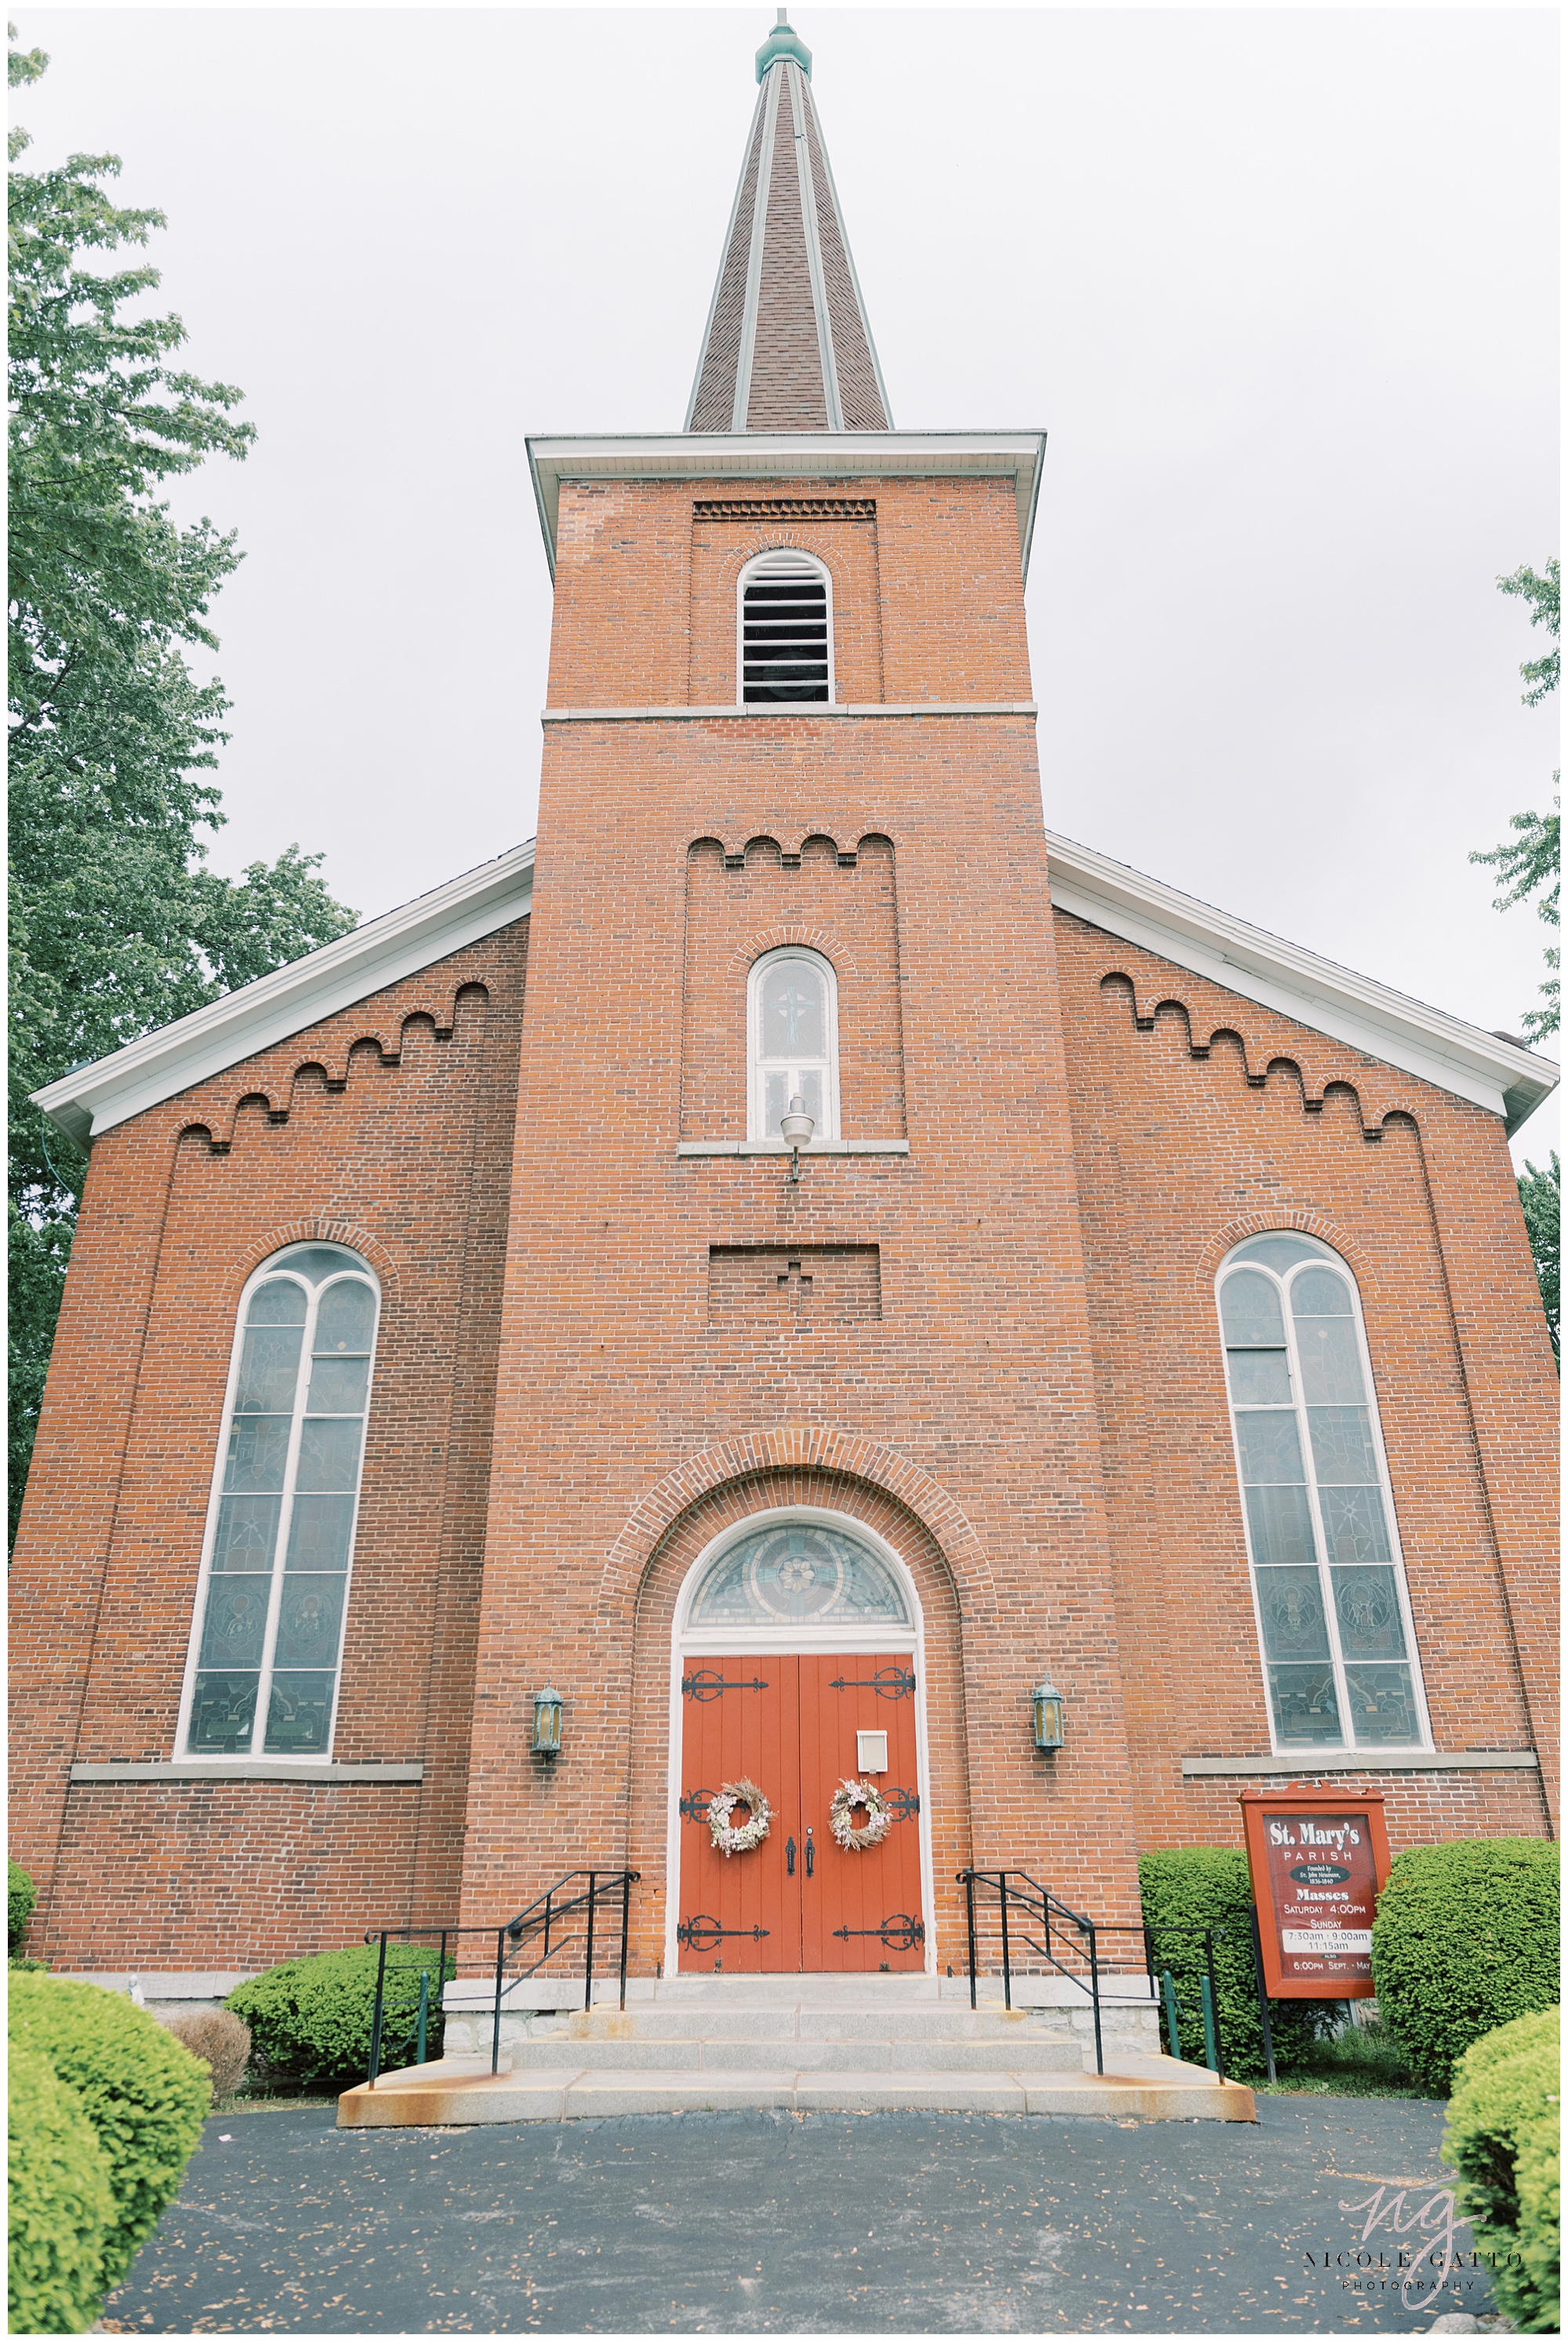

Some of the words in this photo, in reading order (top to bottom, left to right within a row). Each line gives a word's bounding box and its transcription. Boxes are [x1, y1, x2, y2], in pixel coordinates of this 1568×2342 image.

[1269, 1822, 1295, 1846] St.
[1283, 1851, 1352, 1861] PARISH
[1296, 1889, 1349, 1901] Masses
[1284, 1904, 1323, 1914] SATURDAY
[1330, 1904, 1366, 1914] 4:00PM
[1310, 1919, 1342, 1929] SUNDAY
[1288, 1932, 1323, 1941] 7:30am
[1332, 1932, 1368, 1941] 9:00am
[1308, 1941, 1348, 1950] 11:15am
